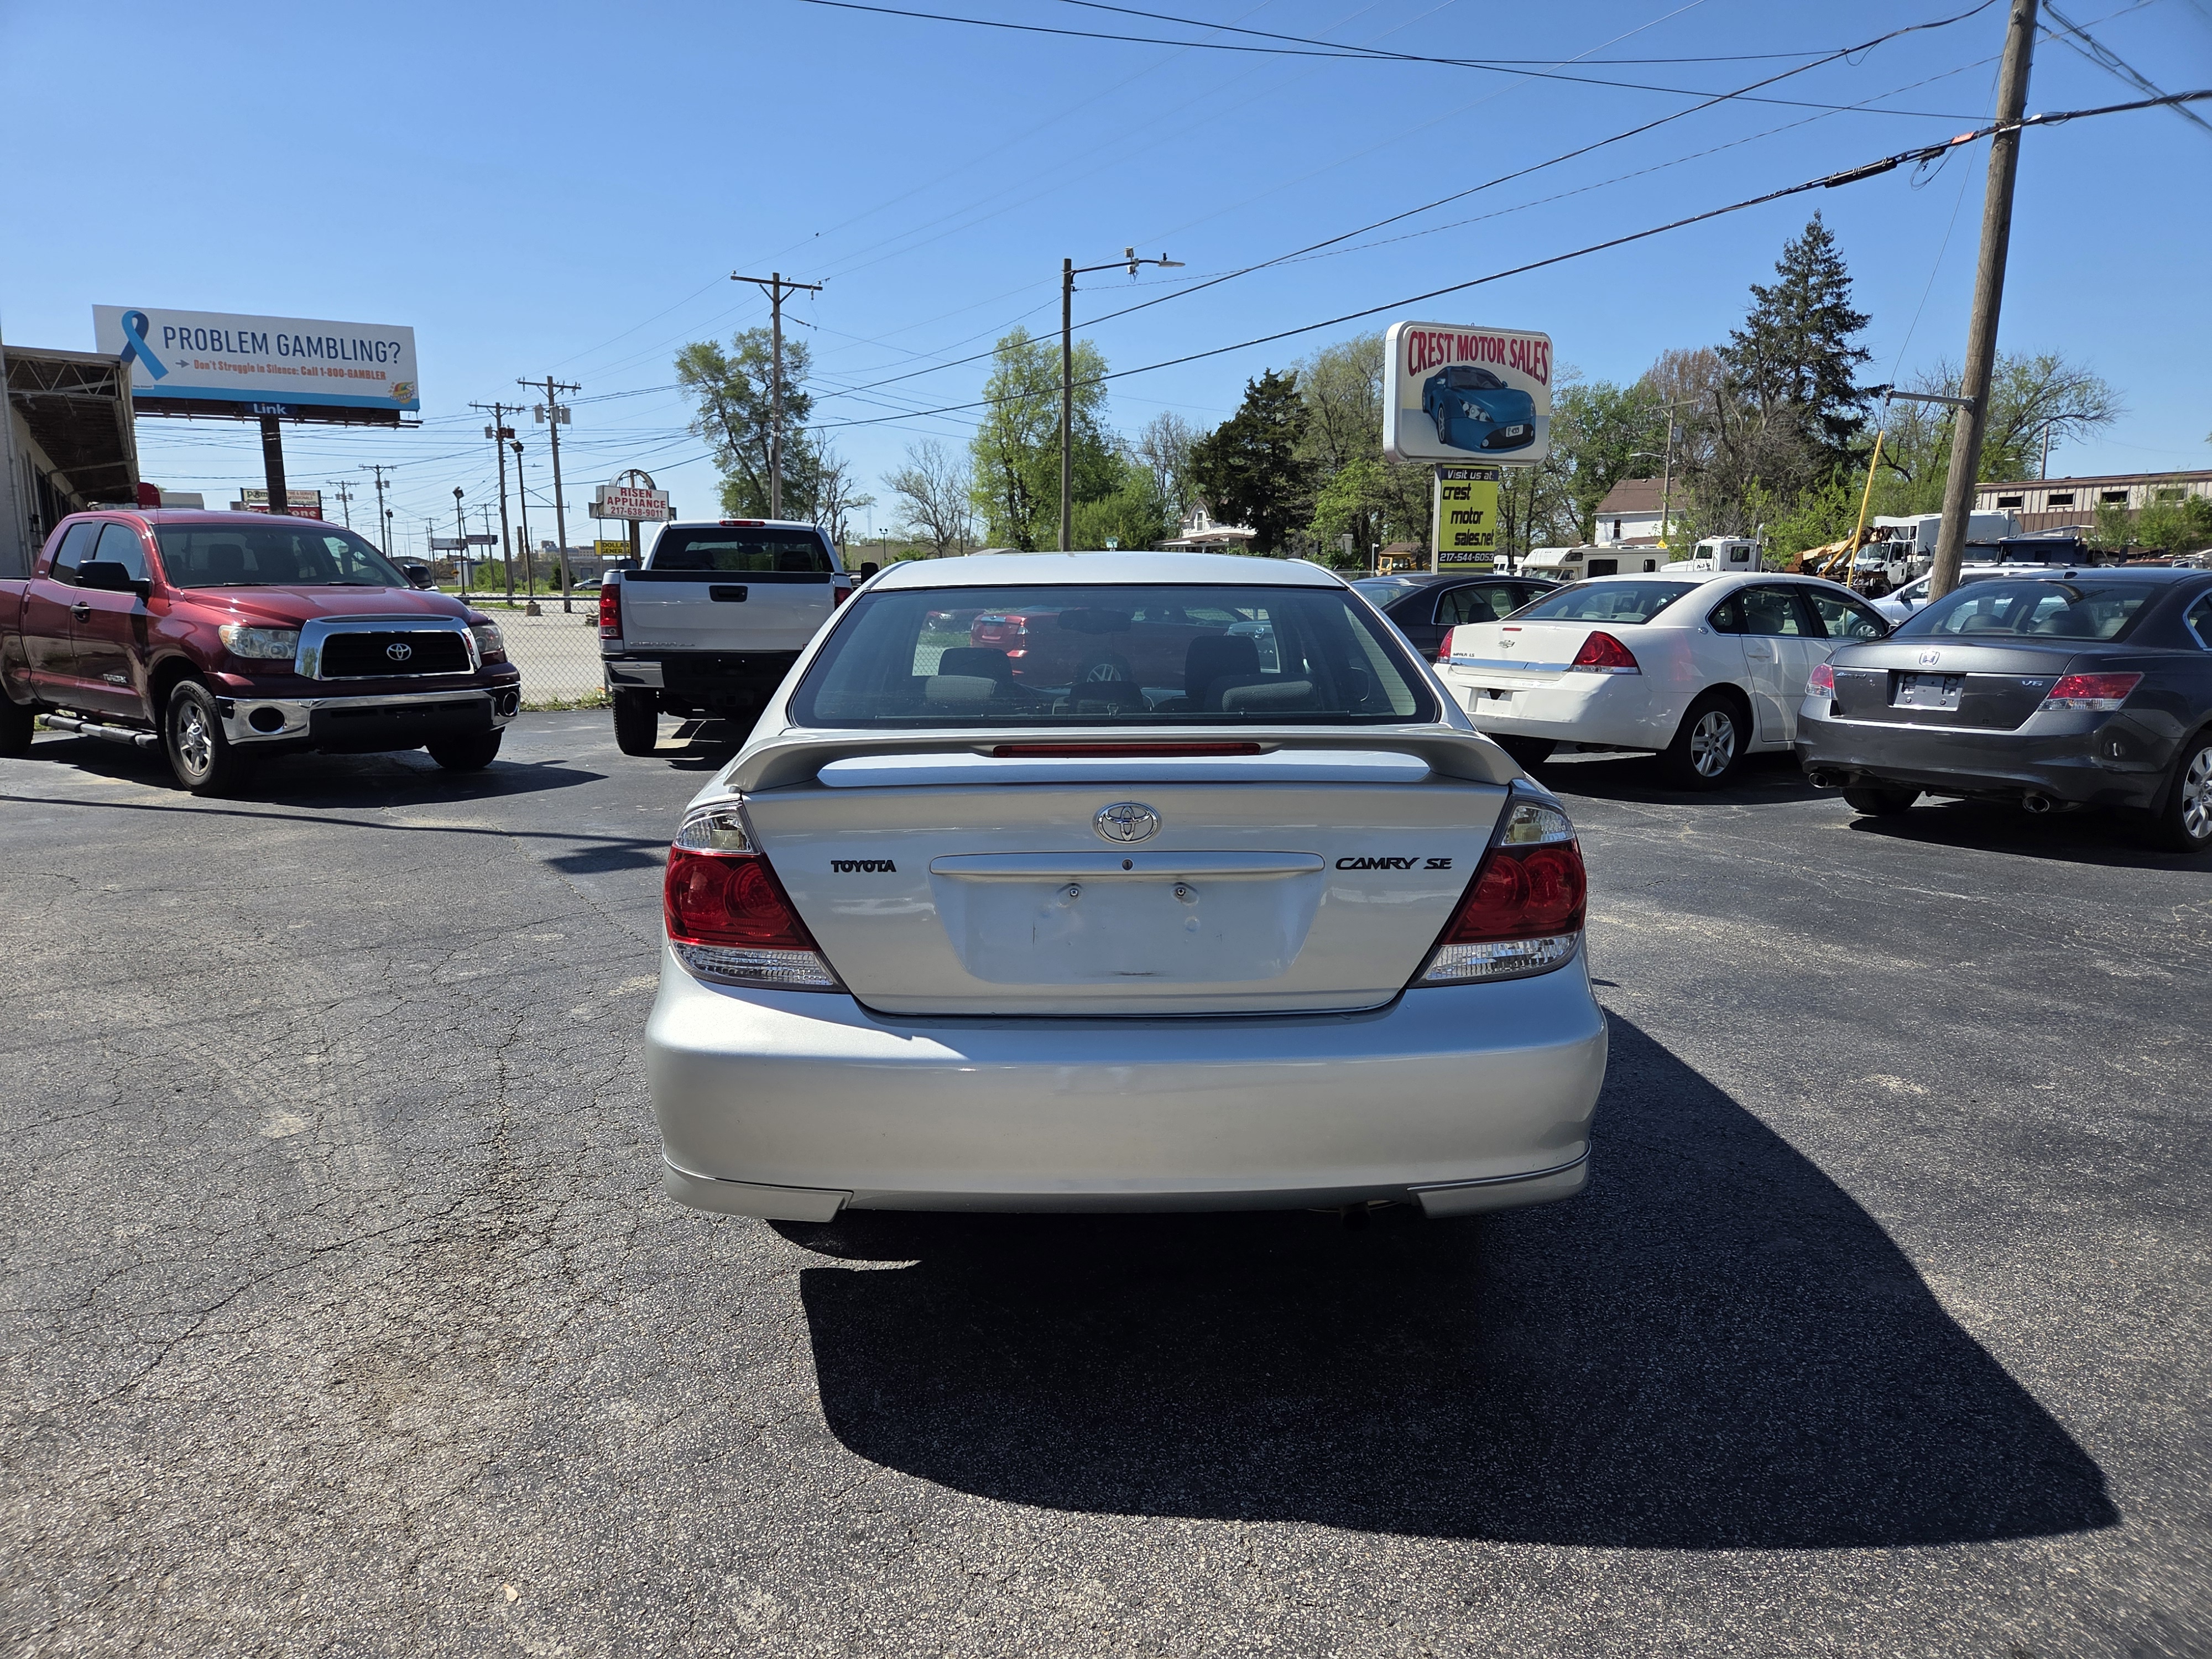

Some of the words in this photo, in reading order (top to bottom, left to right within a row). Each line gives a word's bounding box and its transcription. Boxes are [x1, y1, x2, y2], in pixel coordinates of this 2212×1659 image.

[163, 326, 269, 355] PROBLEM
[276, 333, 401, 364] GAMBLING?
[1408, 331, 1454, 377] CREST
[1457, 335, 1506, 366] MOTOR
[1509, 338, 1548, 387] SALES
[194, 359, 217, 371] Don't
[218, 361, 255, 374] Struggle
[266, 363, 299, 375] Silence:
[300, 366, 319, 376] Call
[320, 367, 387, 380] 1-800-GAMBLER
[253, 403, 288, 415] Link
[1448, 469, 1468, 479] Visit
[1484, 471, 1494, 480] at:
[620, 487, 652, 498] RISEN
[1442, 482, 1472, 500] crest
[607, 496, 666, 509] APPLIANCE
[611, 506, 663, 517] 217-638-9011
[1451, 507, 1484, 524] motor
[1454, 528, 1494, 546] sales.net
[831, 860, 897, 873] TOYOTA
[1335, 857, 1420, 870] CAMRY
[1423, 858, 1453, 870] SE
